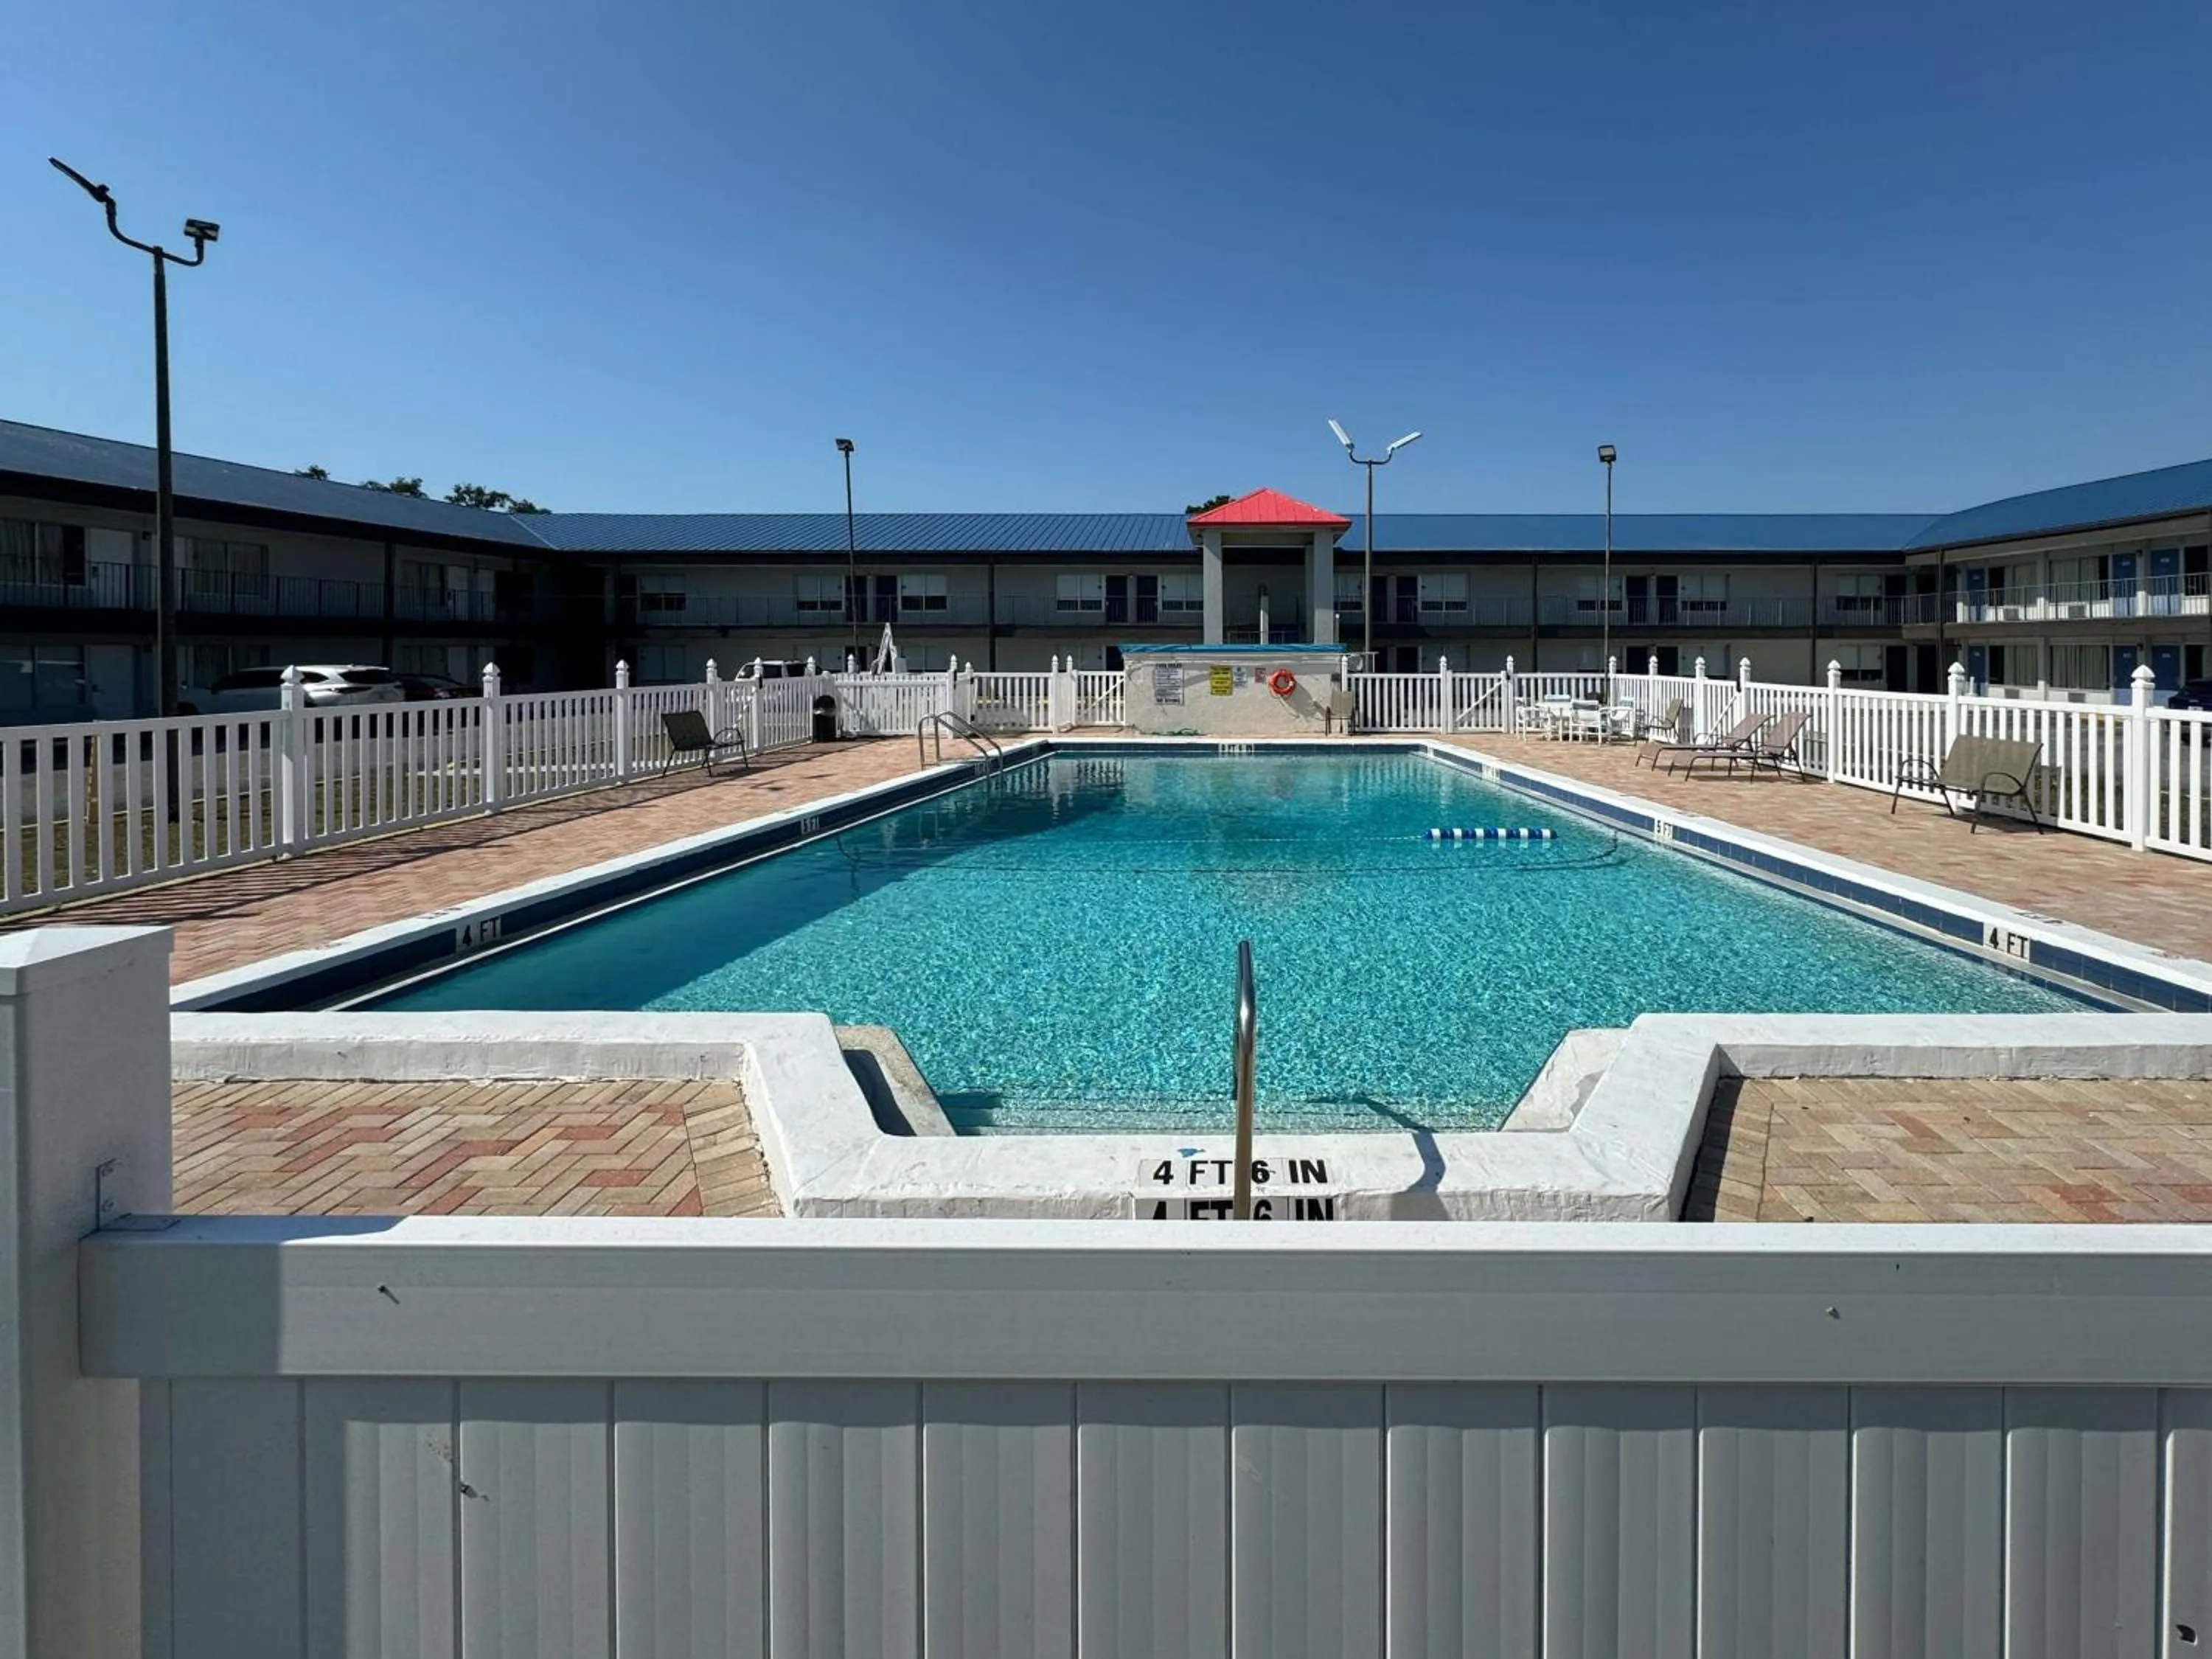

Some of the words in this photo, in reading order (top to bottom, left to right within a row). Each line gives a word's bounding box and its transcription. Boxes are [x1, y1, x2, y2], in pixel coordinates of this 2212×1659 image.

[463, 925, 472, 946] 4
[481, 916, 499, 942] FT
[1989, 927, 1999, 950] 4
[2007, 932, 2028, 958] FT
[1153, 1160, 1174, 1184] 4
[1189, 1160, 1233, 1184] FT
[1251, 1160, 1270, 1183] 6
[1289, 1160, 1328, 1183] IN
[1295, 1198, 1334, 1220] IN
